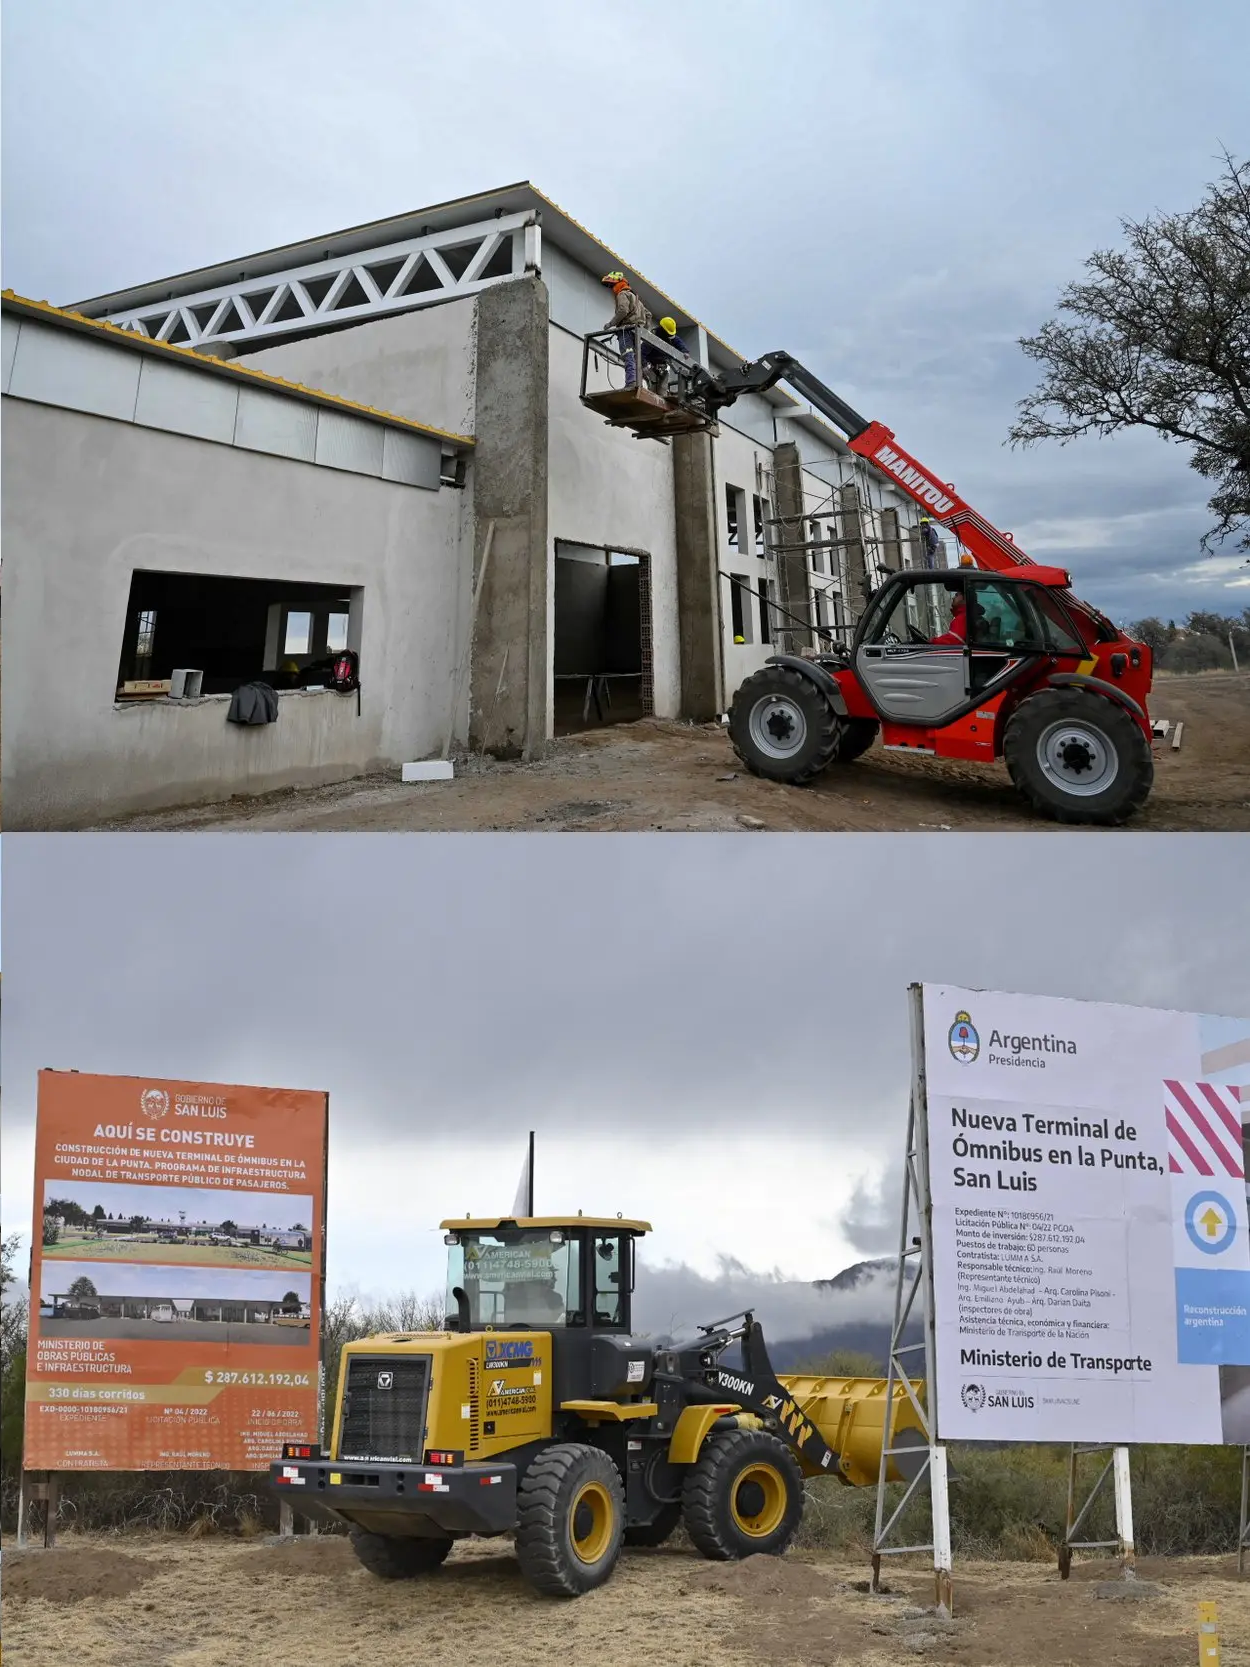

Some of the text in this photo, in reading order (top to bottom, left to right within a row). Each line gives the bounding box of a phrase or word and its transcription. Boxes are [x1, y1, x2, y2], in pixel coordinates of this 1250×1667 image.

[874, 445, 955, 514] MANITOU
[989, 1029, 1077, 1055] Argentina
[989, 1054, 1046, 1068] Presidencia
[175, 1094, 214, 1105] GOBIERNO
[174, 1103, 227, 1119] SAN LUIS
[951, 1107, 1137, 1141] Nueva Terminal de
[93, 1121, 255, 1149] AQUÍ SE CONSTRUYE
[55, 1143, 306, 1169] CONSTRUCCIÓN DE NUEVA TERMINAL DE ÓMNIBUS EN LA
[952, 1133, 1165, 1176] Ómnibus en la Punta,
[54, 1155, 90, 1165] CIUDAD
[91, 1157, 104, 1167] DE
[106, 1158, 118, 1168] LA
[154, 1161, 206, 1174] PROGRAMA
[208, 1164, 220, 1174] DE
[221, 1165, 306, 1180] INFRAESTRUCTURA
[72, 1168, 290, 1190] NODAL DE TRANSPORTE PÚBLICO DE PASAJEROS.
[953, 1167, 1038, 1192] San Luis
[955, 1207, 996, 1218] Expediente
[955, 1218, 990, 1228] Licitación
[991, 1219, 1018, 1230] Pública
[956, 1229, 980, 1238] Monto
[982, 1230, 991, 1239] de
[992, 1231, 1028, 1241] inversión:
[956, 1240, 986, 1249] Puestos
[987, 1241, 996, 1250] de
[998, 1242, 1026, 1253] trabajo:
[1037, 1246, 1069, 1254] personas
[957, 1250, 1000, 1261] Contratista:
[957, 1261, 1003, 1272] Responsable
[1065, 1267, 1093, 1276] Moreno
[957, 1271, 1012, 1283] (Representante
[1060, 1288, 1089, 1297] Carolina
[1003, 1307, 1013, 1315] de
[1014, 1307, 1033, 1317] obra)
[1183, 1304, 1247, 1316] Reconstrucción
[959, 1315, 1110, 1329] Asistencia técnica, económica y financiera:
[1183, 1316, 1224, 1328] argentina
[959, 1326, 1090, 1339] Ministerio de Transporte de la Nación
[37, 1340, 106, 1351] MINISTERIO DE
[499, 1341, 534, 1359] XCMG
[37, 1350, 69, 1361] OBRAS
[960, 1348, 1152, 1375] Ministerio de Transporte
[36, 1362, 132, 1374] E INFRAESTRUCTURA
[204, 1370, 310, 1387] $ 287.612.192,04
[48, 1388, 70, 1398] 330
[98, 1389, 146, 1400] corridos
[987, 1395, 1009, 1408] SAN
[1011, 1396, 1034, 1409] LUIS
[59, 1414, 107, 1422] EXPEDIENTE
[190, 1408, 208, 1416] 2022
[251, 1409, 261, 1417] 22
[281, 1410, 299, 1418] 2022
